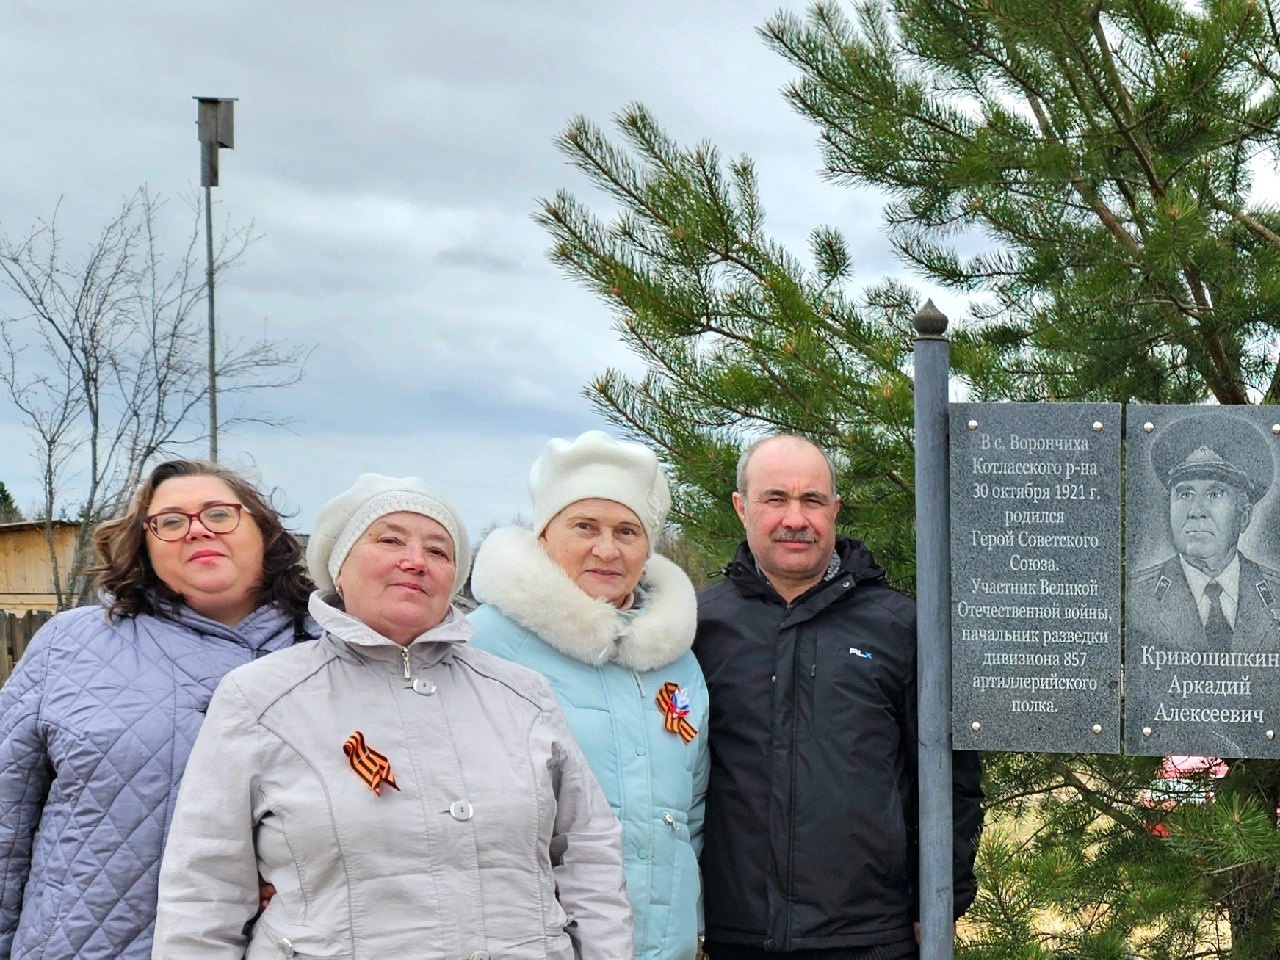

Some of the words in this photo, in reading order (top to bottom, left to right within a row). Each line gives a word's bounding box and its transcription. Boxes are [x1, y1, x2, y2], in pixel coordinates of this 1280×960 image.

[981, 435, 990, 449] В
[994, 439, 1005, 450] с.
[1010, 434, 1089, 454] Ворончиха
[972, 458, 1062, 475] Котласского
[1066, 462, 1097, 479] р-на
[973, 483, 988, 498] 30
[992, 482, 1050, 503] октября
[1055, 485, 1085, 499] 1921
[1089, 489, 1100, 500] г.
[1005, 511, 1064, 526] родился
[972, 531, 1014, 550] Герой
[1018, 531, 1099, 548] Советского
[1009, 555, 1059, 571] Союза.
[972, 579, 1036, 594] Участник
[1041, 579, 1098, 596] Великой
[958, 602, 1060, 618] Отечественной
[1064, 603, 1111, 621] войны,
[962, 629, 1039, 642] начальник
[1043, 631, 1108, 646] разведки
[983, 654, 1059, 666] дивизиона
[1063, 652, 1087, 666] 857
[1141, 646, 1280, 670] Кривошапкин
[973, 674, 1097, 692] артиллерийского
[1168, 675, 1251, 698] Аркадий
[1012, 700, 1058, 713] полка.
[1154, 703, 1264, 723] Алексеевич
